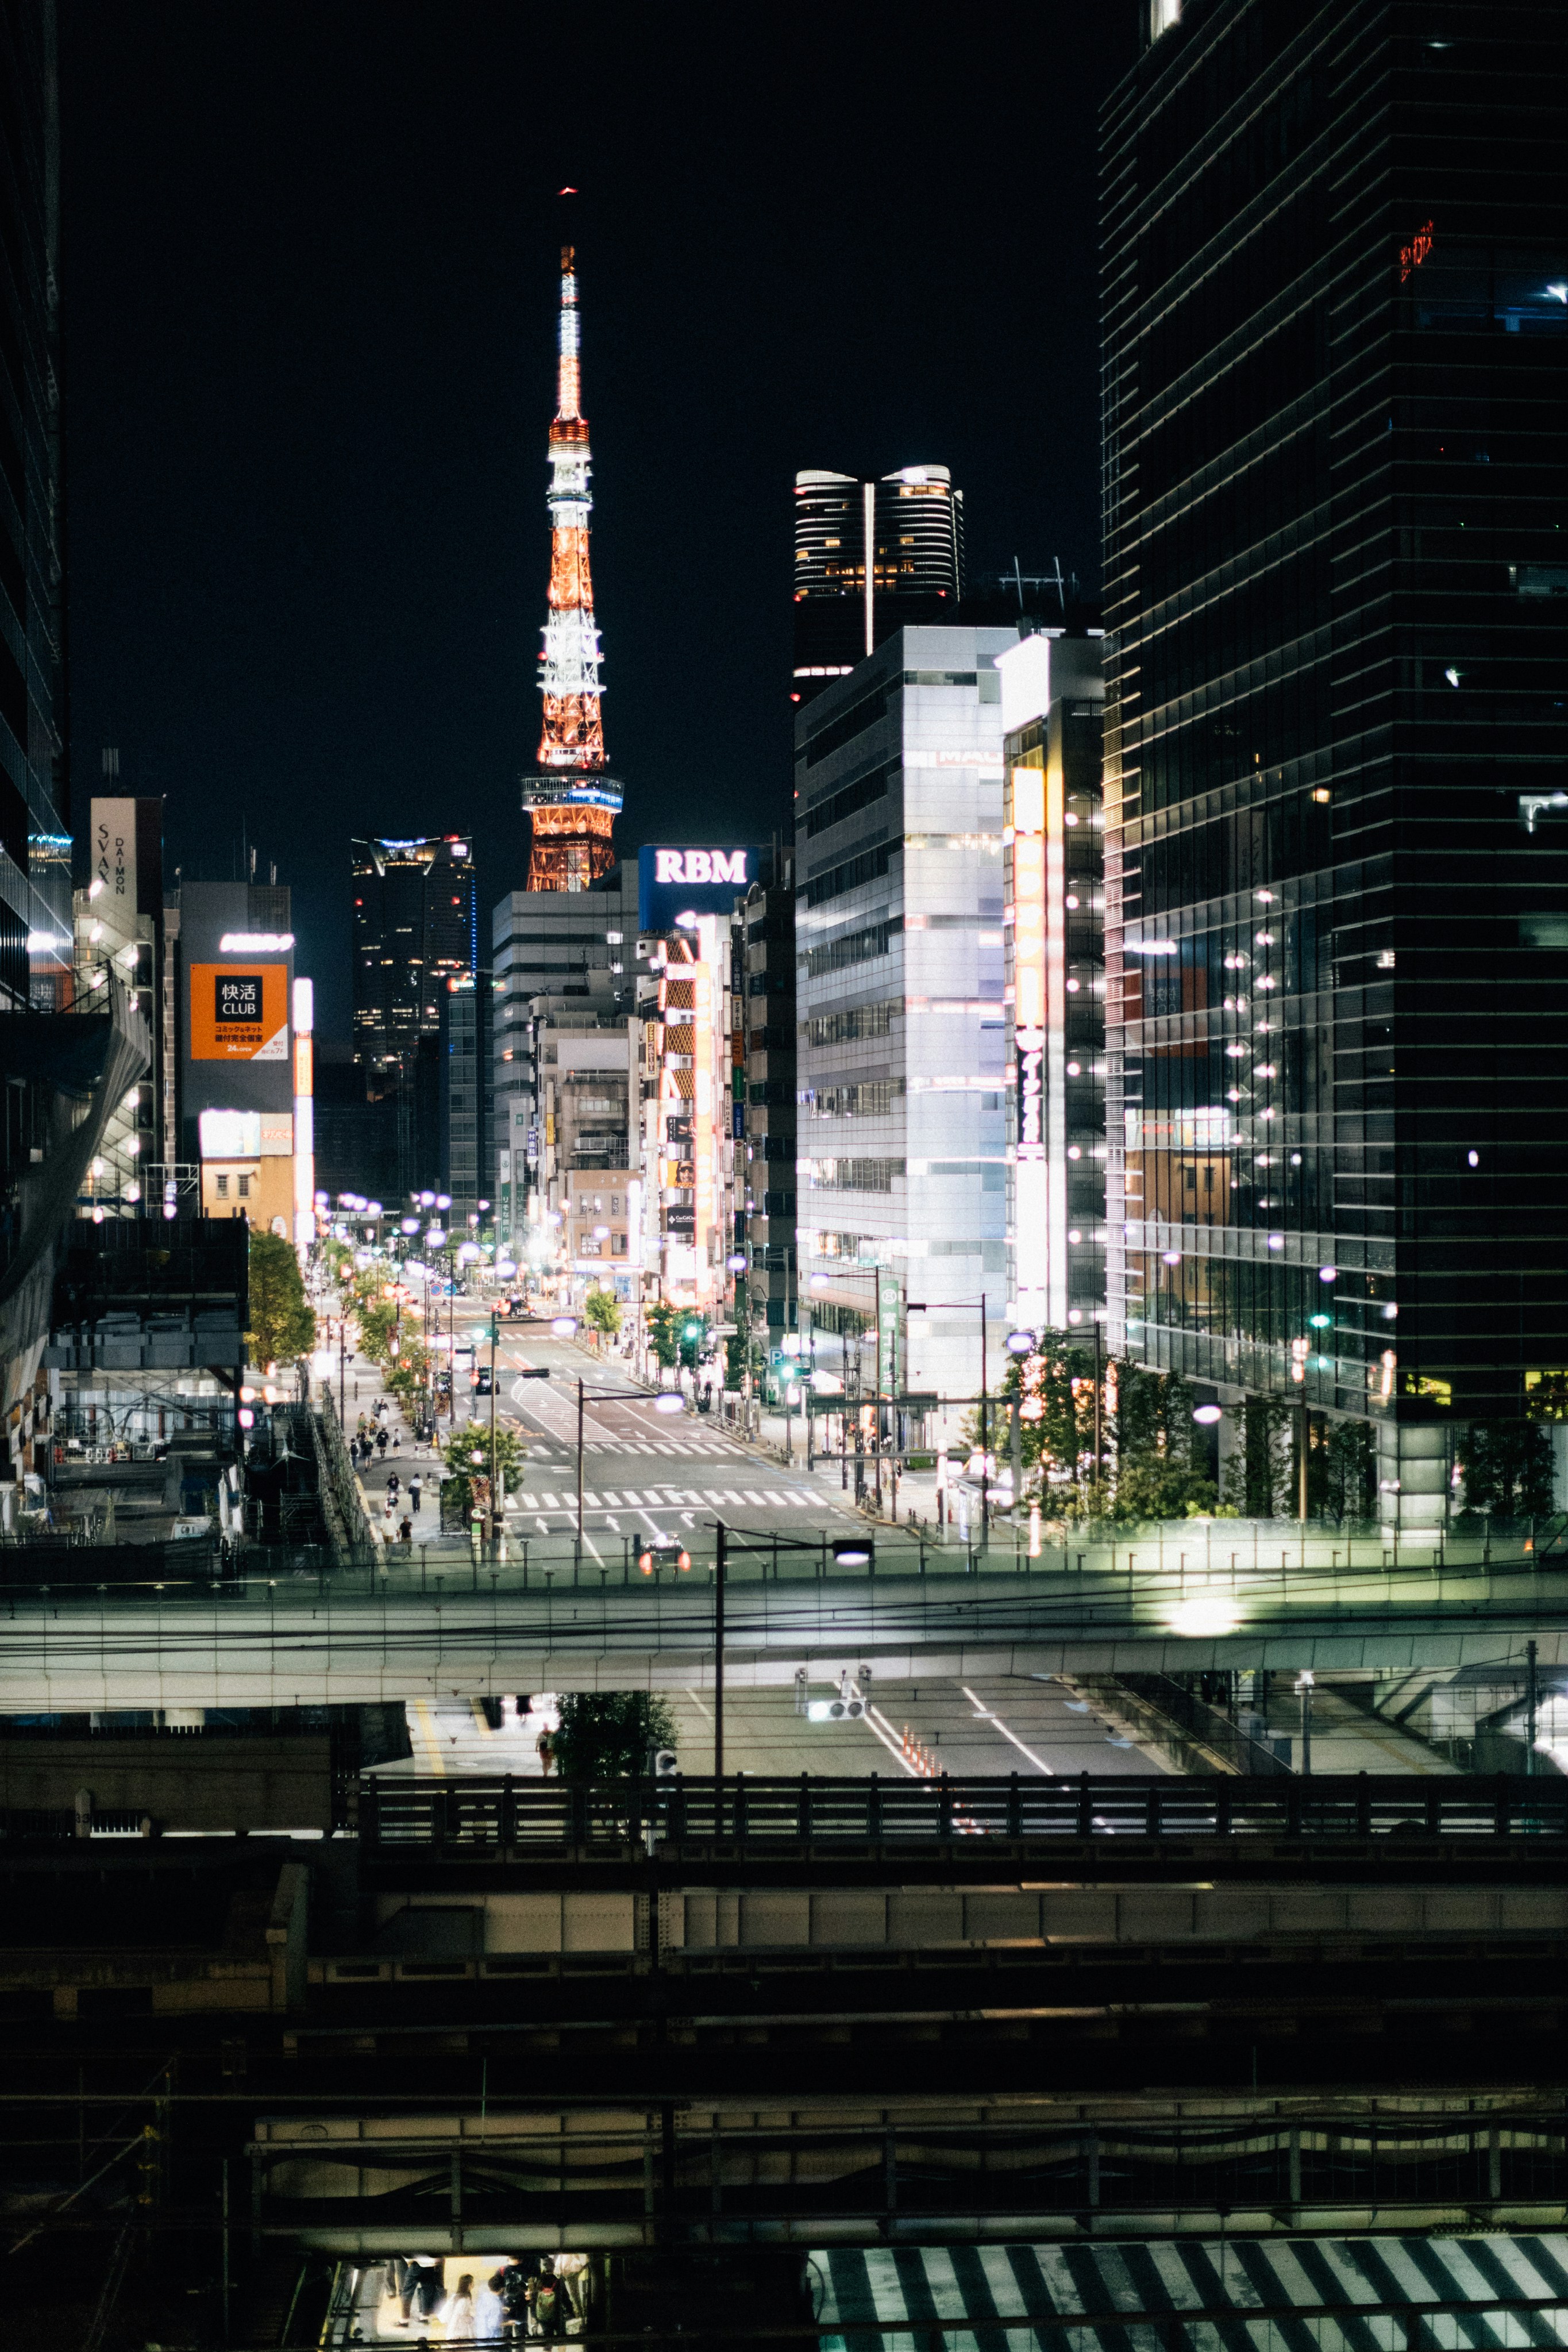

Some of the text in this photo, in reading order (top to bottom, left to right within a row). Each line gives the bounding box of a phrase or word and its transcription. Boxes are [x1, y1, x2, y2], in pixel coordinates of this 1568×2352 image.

[98, 823, 109, 884] SVAX
[655, 849, 747, 883] RBM
[115, 838, 125, 895] DAIMON
[222, 984, 256, 1000] 快活
[222, 1003, 256, 1014] CLUB
[772, 1350, 783, 1365] P
